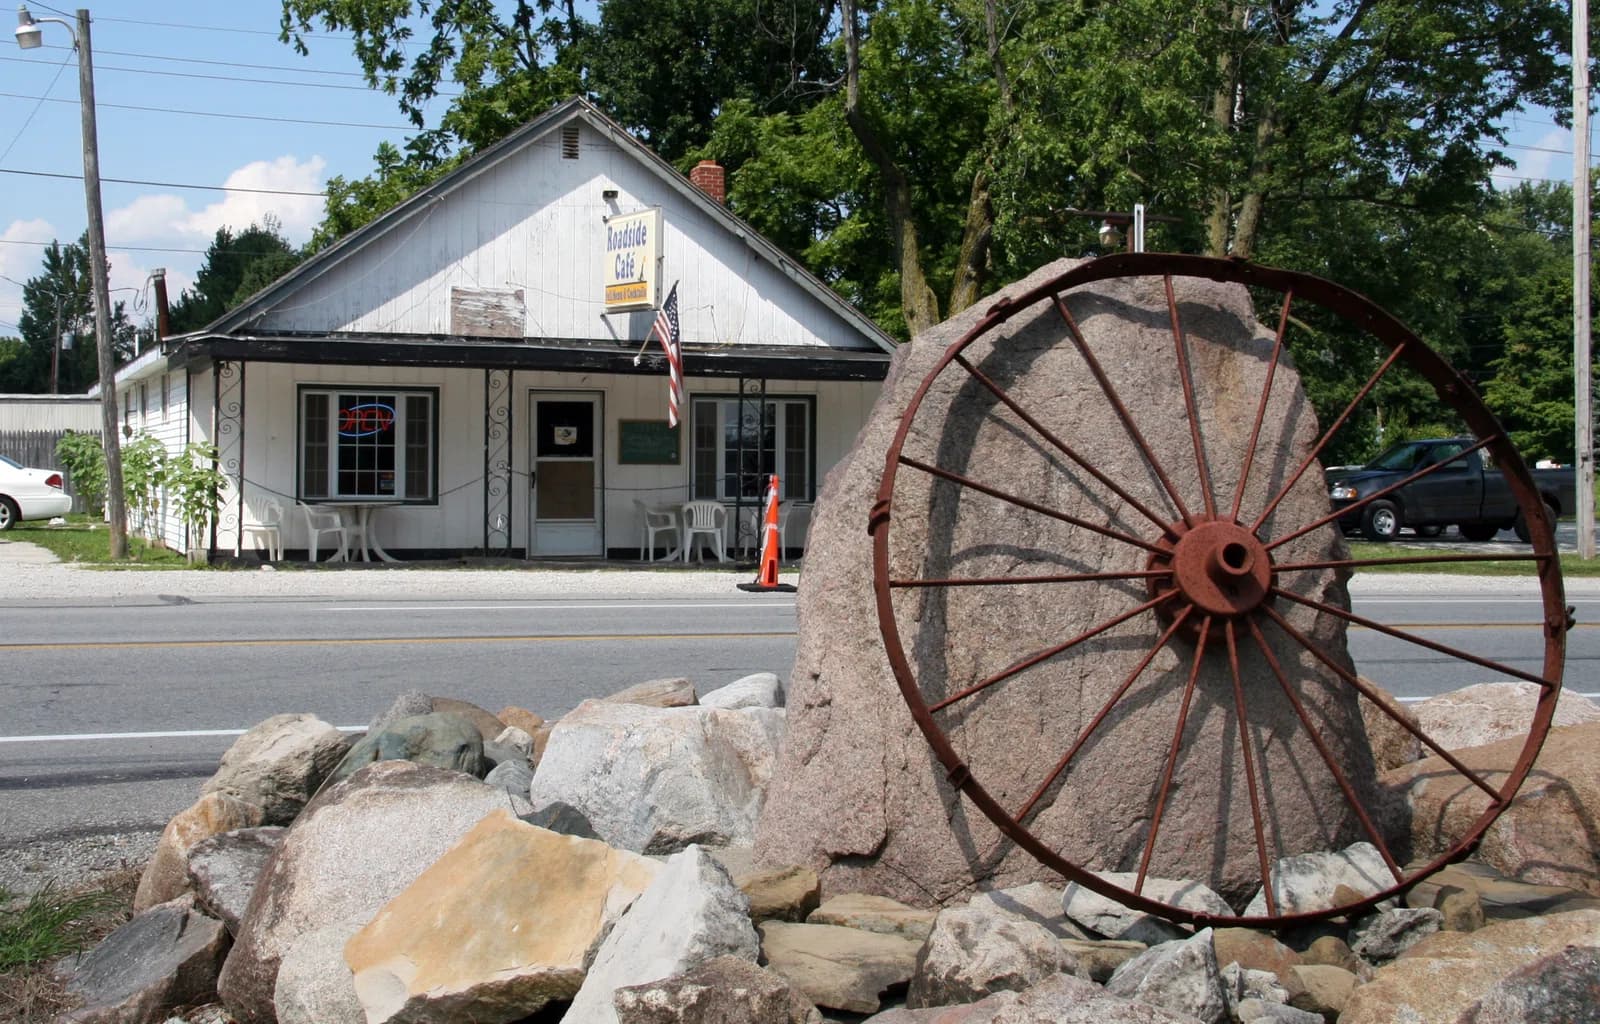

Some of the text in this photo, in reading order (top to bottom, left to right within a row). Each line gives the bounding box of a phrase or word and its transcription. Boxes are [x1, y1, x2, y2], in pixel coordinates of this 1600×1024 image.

[607, 220, 647, 251] Roadside
[615, 252, 635, 280] Café
[338, 409, 391, 431] OPEN
